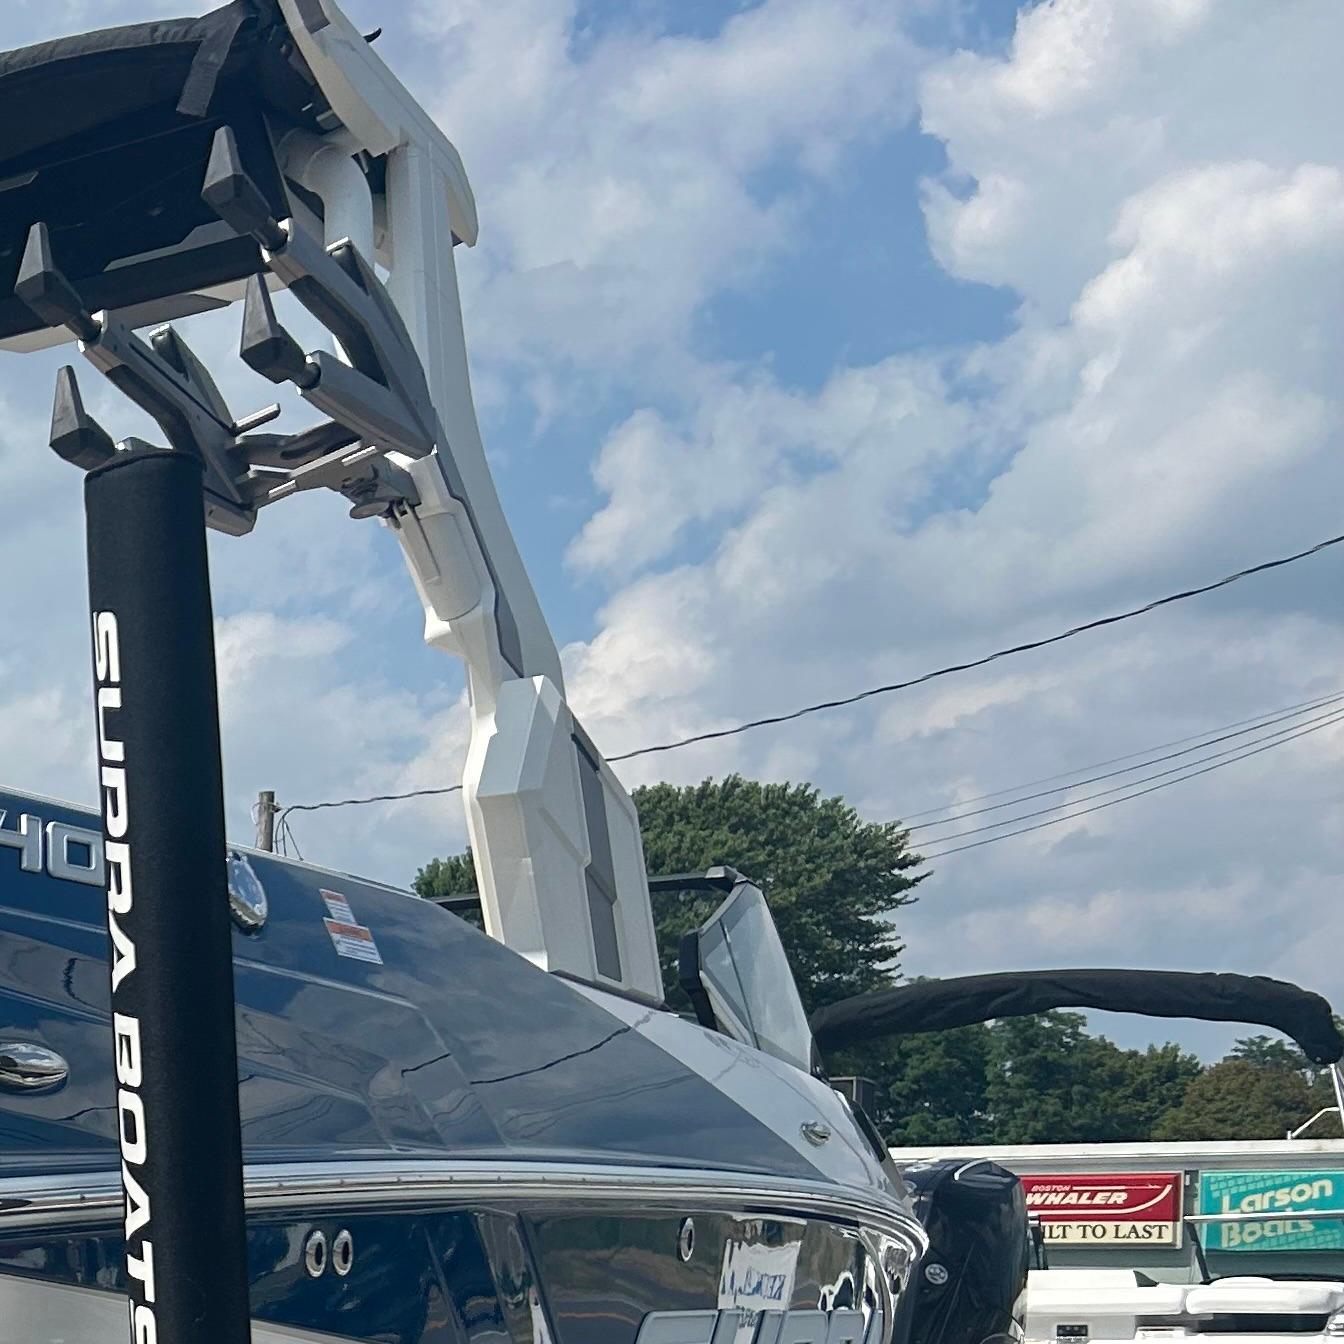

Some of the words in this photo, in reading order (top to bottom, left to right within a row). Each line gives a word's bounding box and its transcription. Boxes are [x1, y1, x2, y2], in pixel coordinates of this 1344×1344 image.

[93, 609, 138, 993] SUPRA
[1031, 1184, 1071, 1192] BOSTON
[1025, 1191, 1128, 1205] WHALER
[1221, 1179, 1333, 1214] Larson
[1042, 1224, 1073, 1239] ILT
[1076, 1224, 1107, 1239] TO
[1113, 1224, 1169, 1240] LAST
